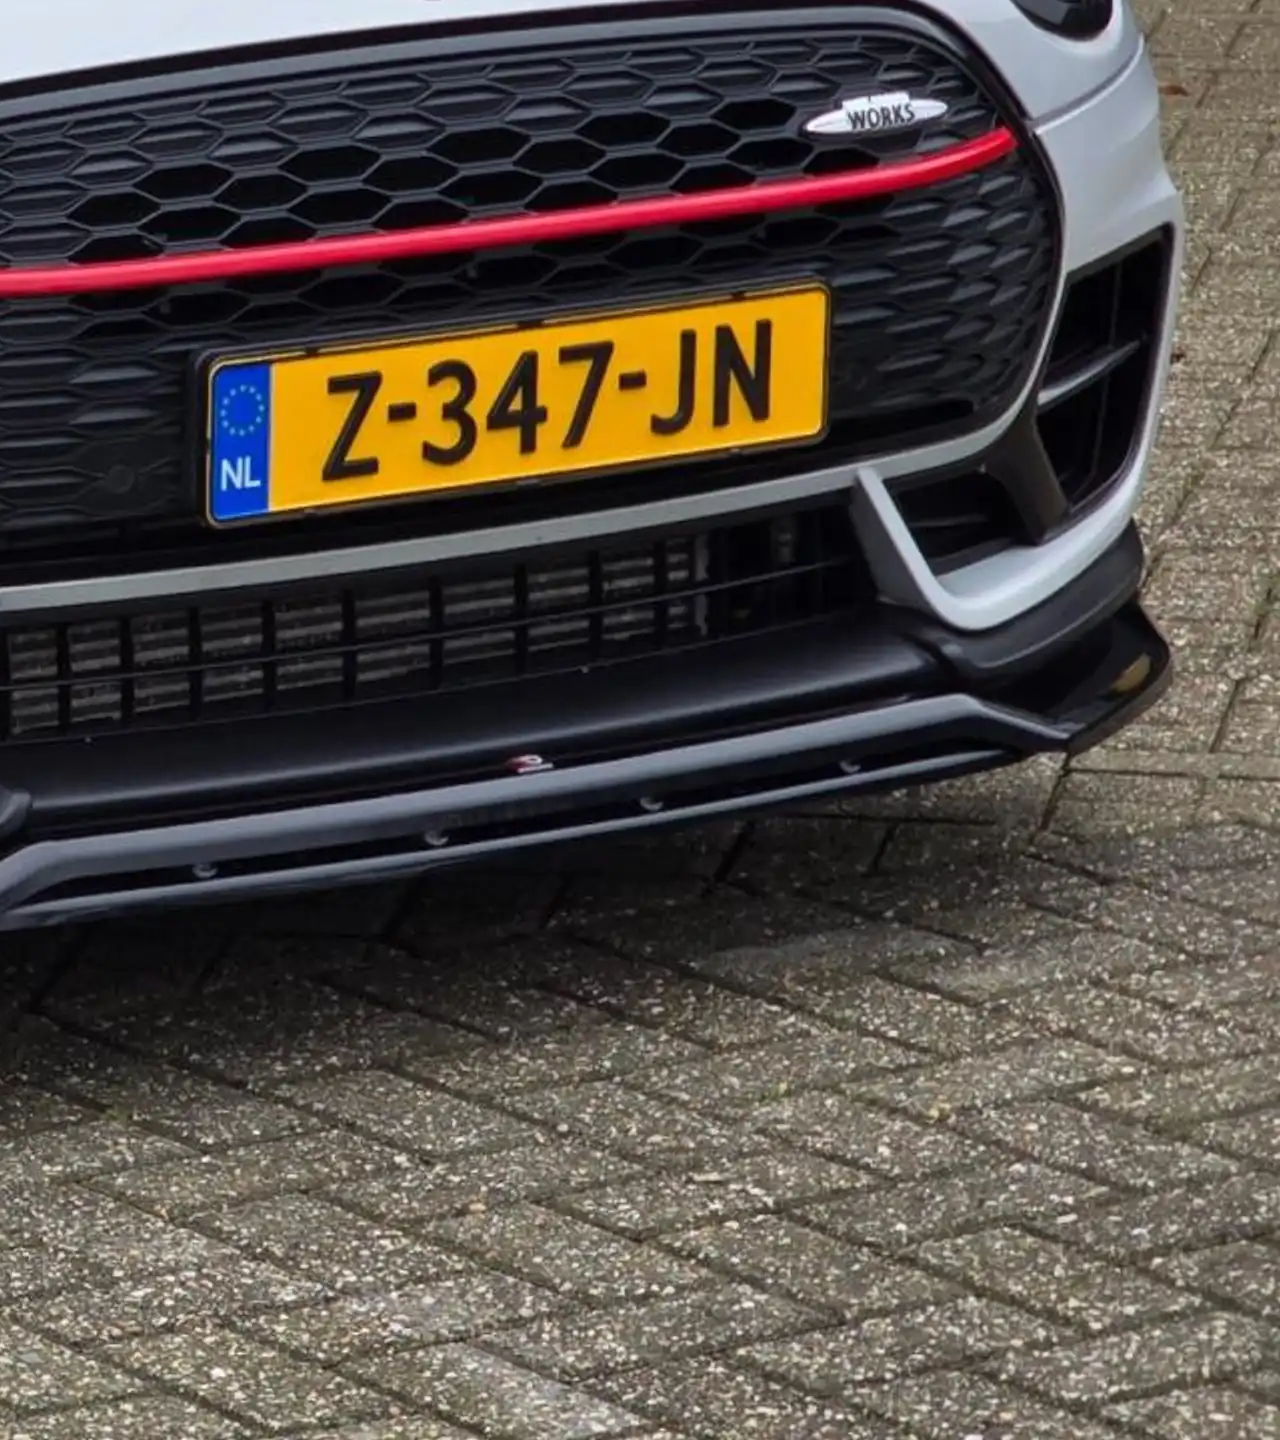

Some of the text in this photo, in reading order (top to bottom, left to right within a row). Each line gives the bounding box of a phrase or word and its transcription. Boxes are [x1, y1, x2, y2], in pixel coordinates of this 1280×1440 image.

[846, 102, 916, 130] WORKS
[320, 318, 773, 483] Z-347-JN
[220, 456, 261, 492] NL
